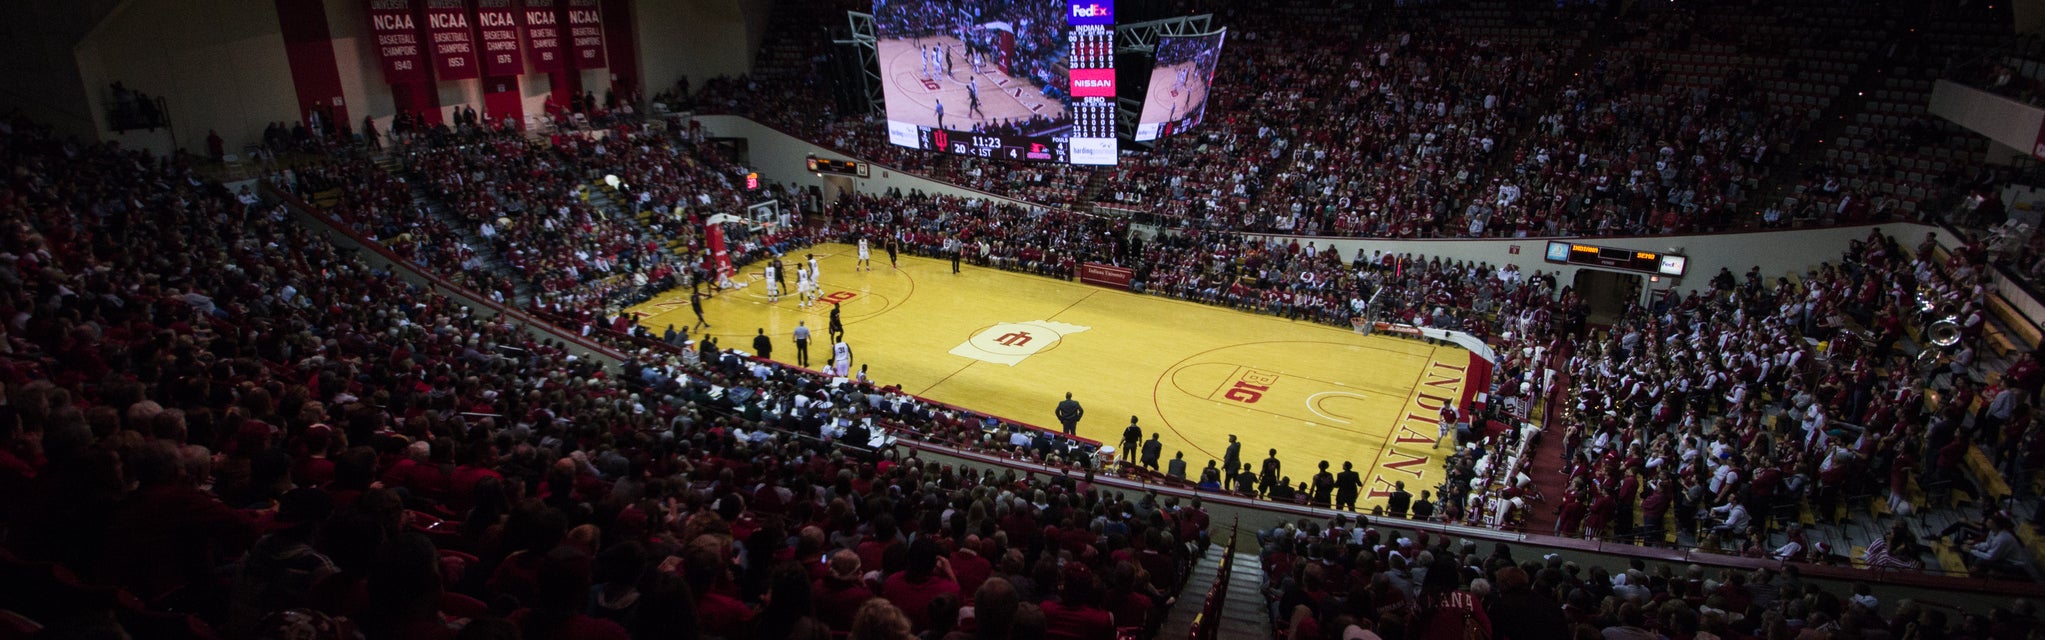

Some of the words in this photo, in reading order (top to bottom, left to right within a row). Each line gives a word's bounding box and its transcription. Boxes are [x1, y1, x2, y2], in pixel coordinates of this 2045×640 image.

[1073, 4, 1107, 17] FedEx
[430, 13, 468, 28] NCAA
[480, 12, 515, 26] NCAA
[526, 11, 556, 25] NCAA
[569, 10, 600, 23] NCAA
[373, 14, 415, 30] NCAA
[484, 30, 516, 40] BASKETBALL
[530, 29, 557, 38] BASKETBALL
[572, 27, 600, 36] BASKETBALL
[379, 34, 416, 45] BASKETBALL
[434, 32, 470, 43] BASKETBALL
[575, 37, 600, 46] CHAMPIONS
[438, 43, 470, 54] CHAMPIONS
[487, 41, 516, 51] CHAMPIONS
[533, 39, 557, 48] CHAMPIONS
[382, 46, 417, 56] CHAMPIONS
[448, 57, 464, 67] 1953
[497, 54, 512, 64] 1976
[394, 60, 412, 70] 1940
[972, 136, 1001, 148] 11:23
[954, 144, 966, 154] 20
[979, 148, 992, 157] 1ST
[1010, 149, 1017, 159] 4
[1572, 245, 1598, 253] INDIANA
[1367, 361, 1468, 500] INDIANA
